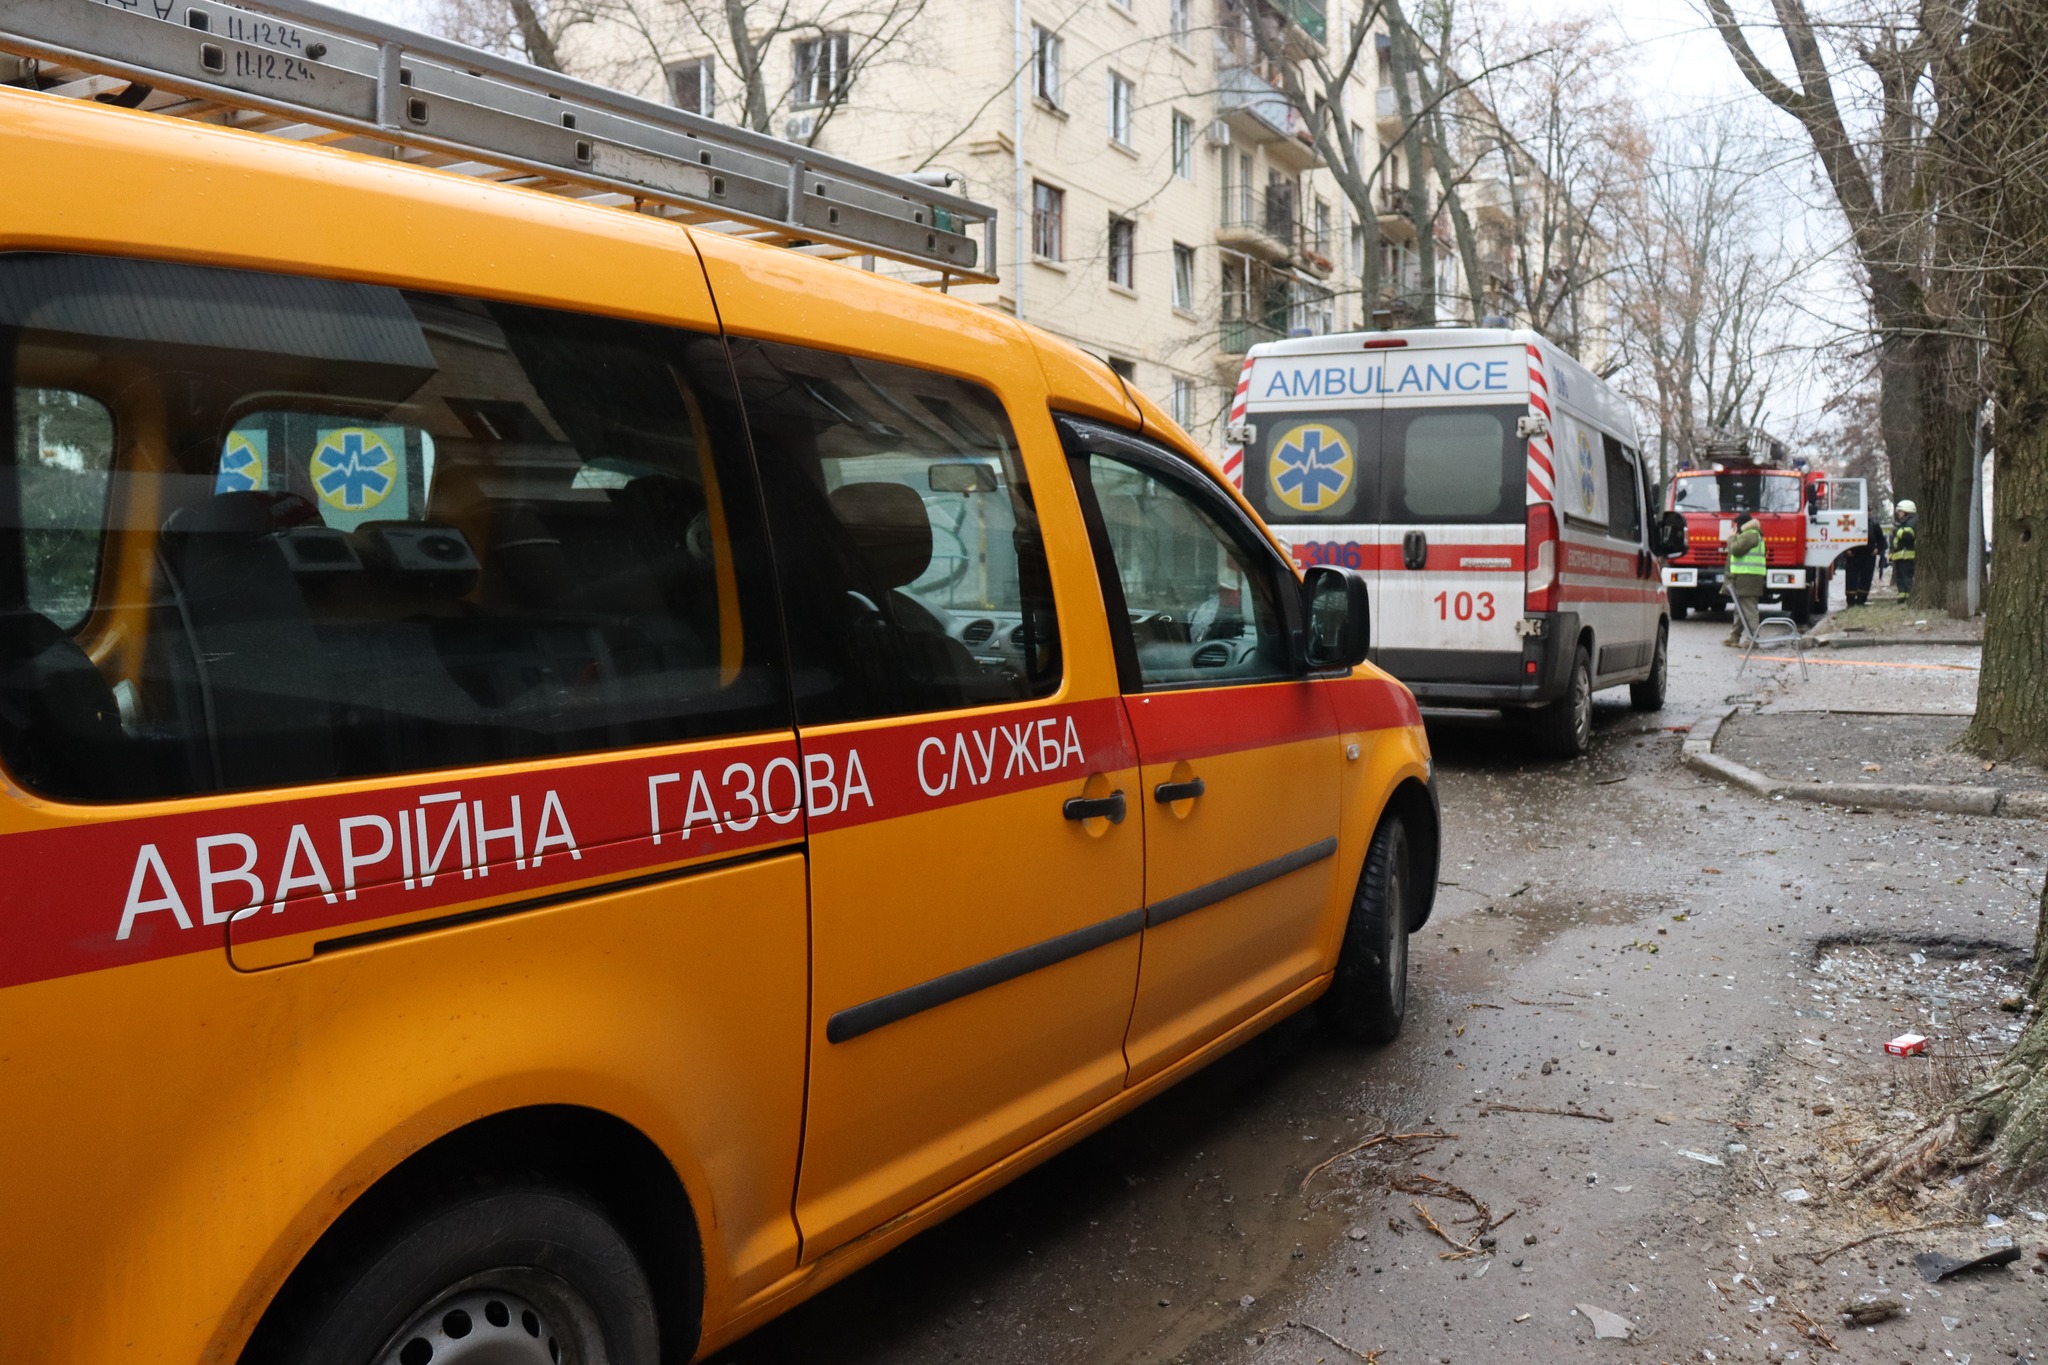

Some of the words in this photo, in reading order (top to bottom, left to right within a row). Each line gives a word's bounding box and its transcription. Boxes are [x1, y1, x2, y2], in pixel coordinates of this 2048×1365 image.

[229, 15, 301, 48] 11.12.24
[1266, 361, 1509, 397] AMBULANCE
[1820, 527, 1828, 541] 9
[1305, 541, 1361, 570] 306
[1434, 591, 1495, 621] 103
[115, 789, 583, 941] АВАРІЙНА
[647, 748, 874, 845] ГАЗОВА
[917, 715, 1085, 797] СЛУЖБА
